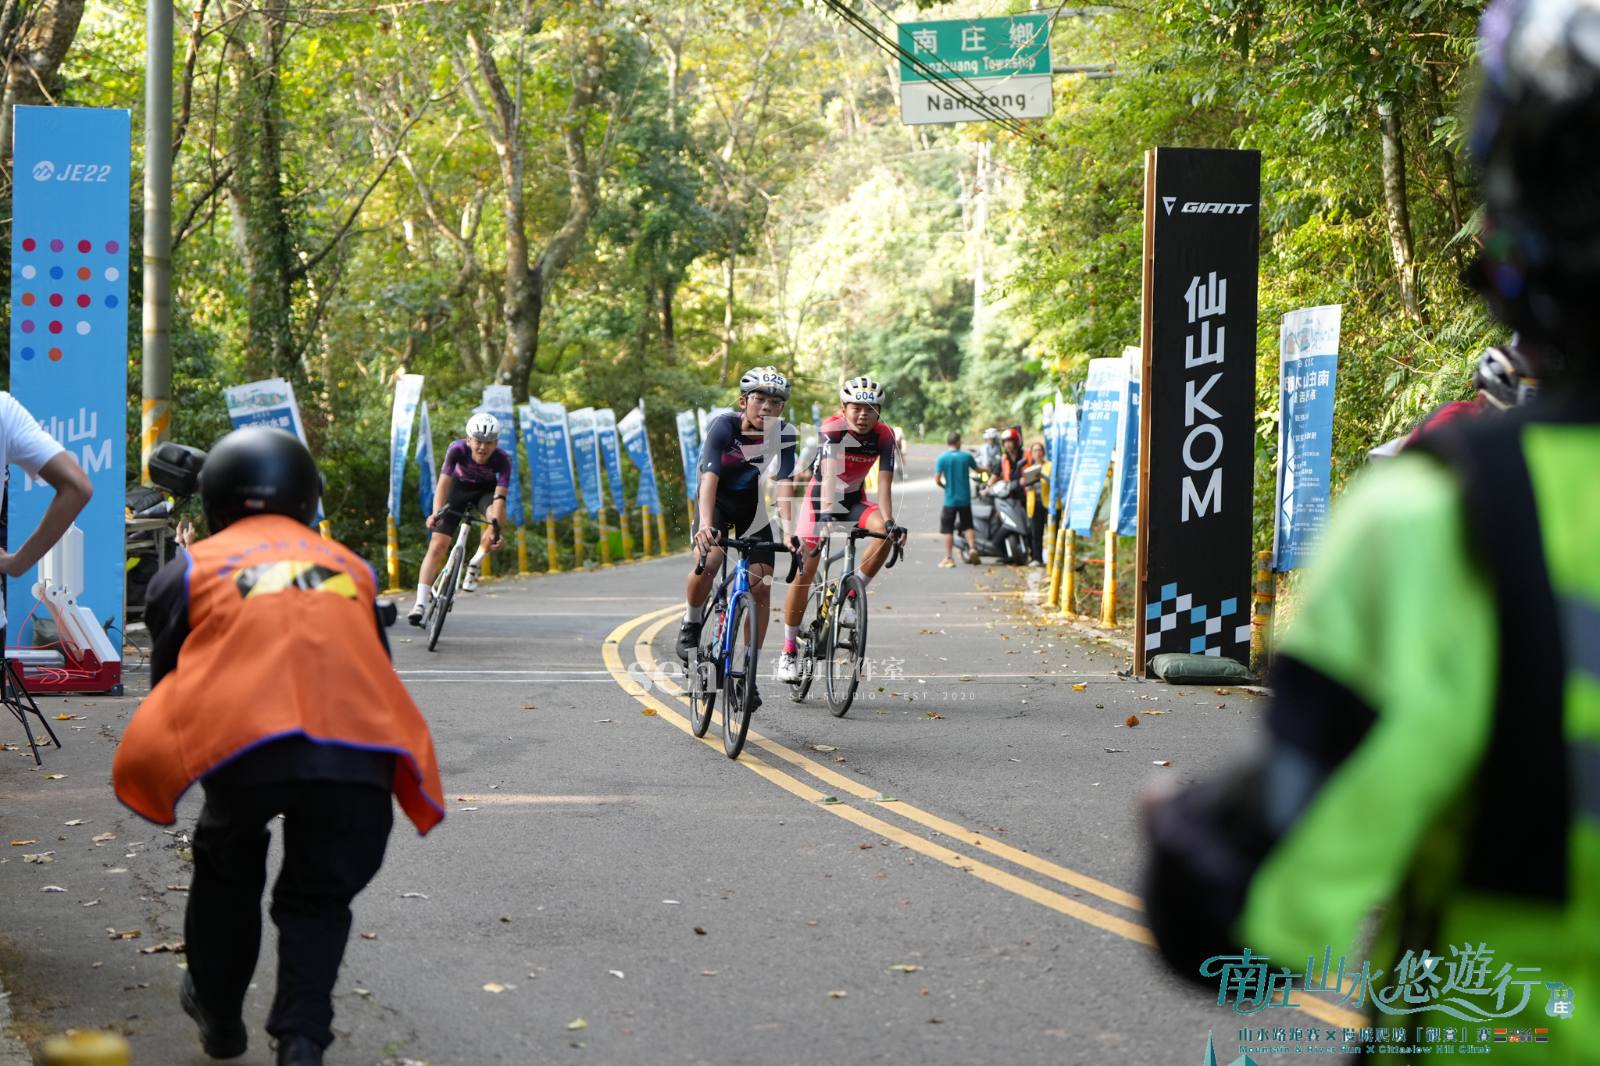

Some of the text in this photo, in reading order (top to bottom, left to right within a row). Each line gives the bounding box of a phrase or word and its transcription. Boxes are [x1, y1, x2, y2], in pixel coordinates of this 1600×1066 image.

[912, 22, 1035, 55] 南庄鄉
[56, 163, 111, 182] JE22
[1181, 201, 1253, 214] GIANT
[762, 373, 784, 386] 625
[855, 391, 875, 401] 604
